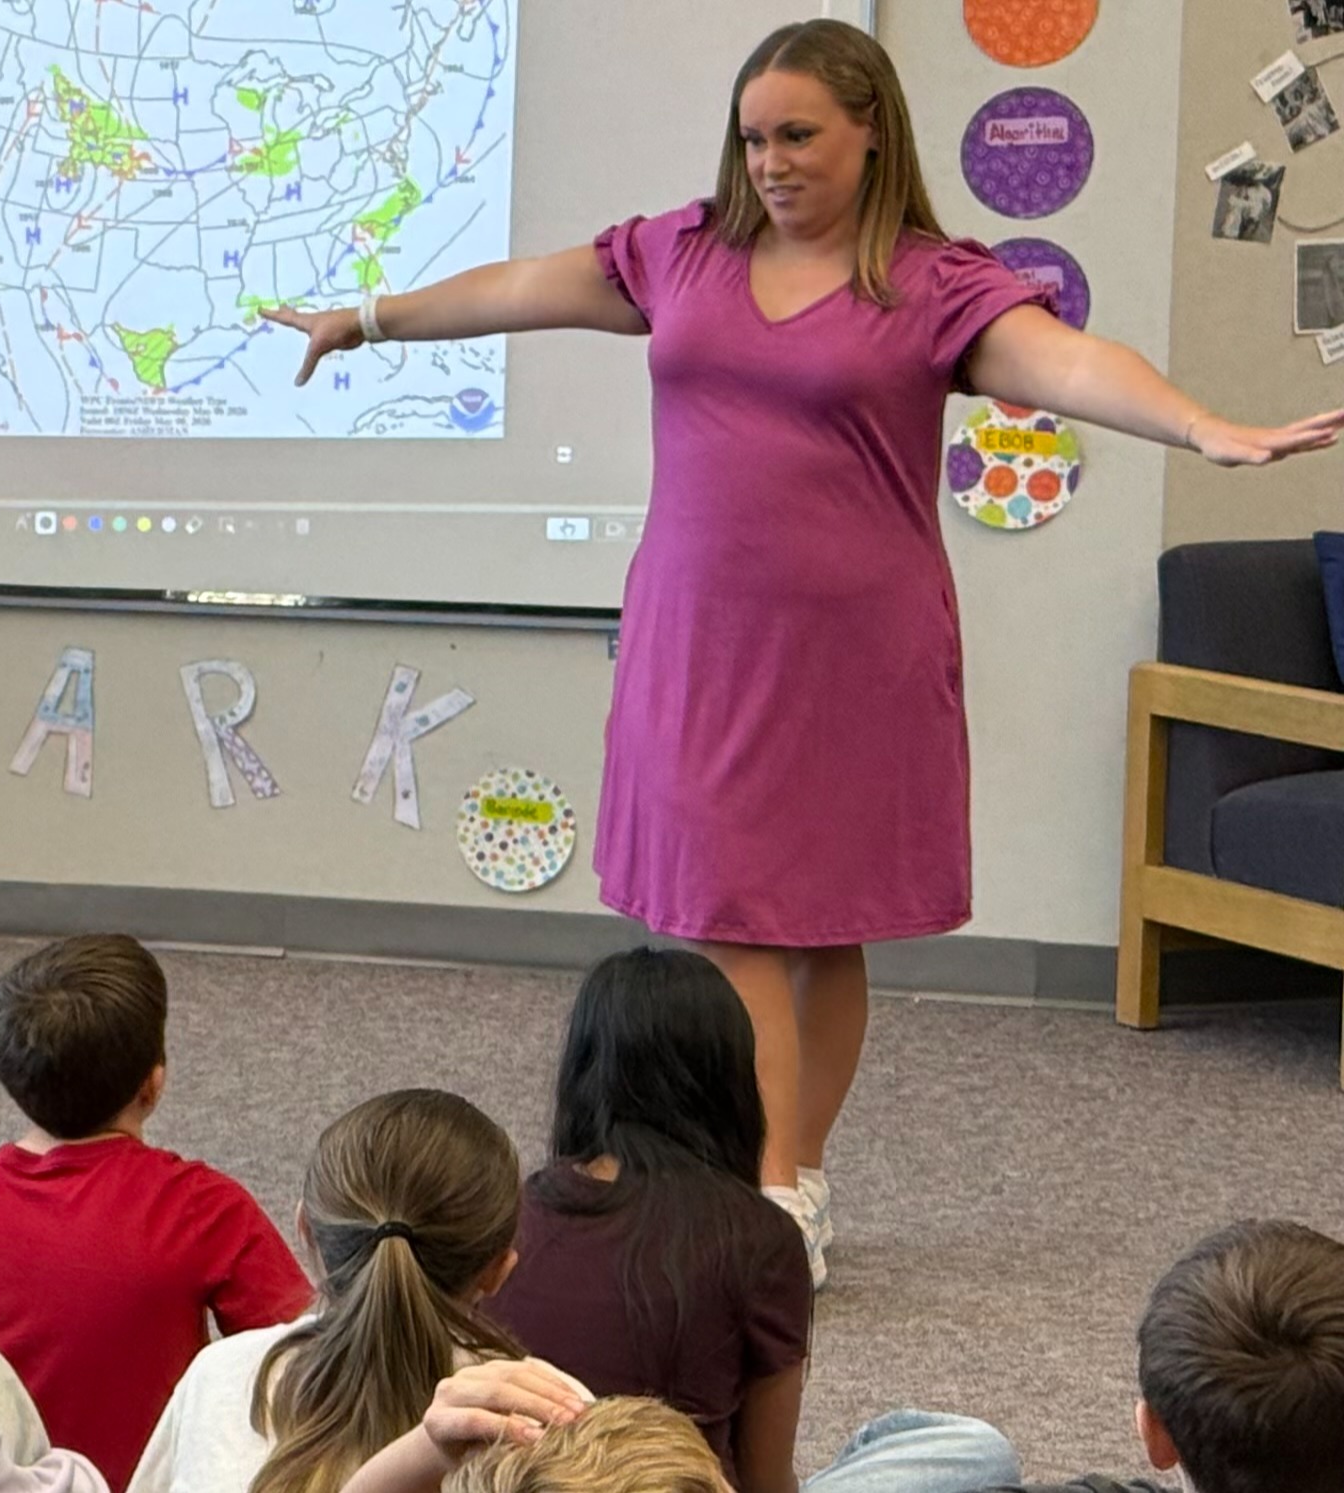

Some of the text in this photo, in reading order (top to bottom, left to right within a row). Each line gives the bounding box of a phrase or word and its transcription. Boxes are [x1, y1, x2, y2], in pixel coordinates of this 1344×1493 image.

[172, 87, 189, 105] H
[55, 176, 72, 194] H
[285, 181, 302, 202] H
[25, 226, 42, 245] H
[223, 250, 240, 268] H
[333, 372, 351, 391] H
